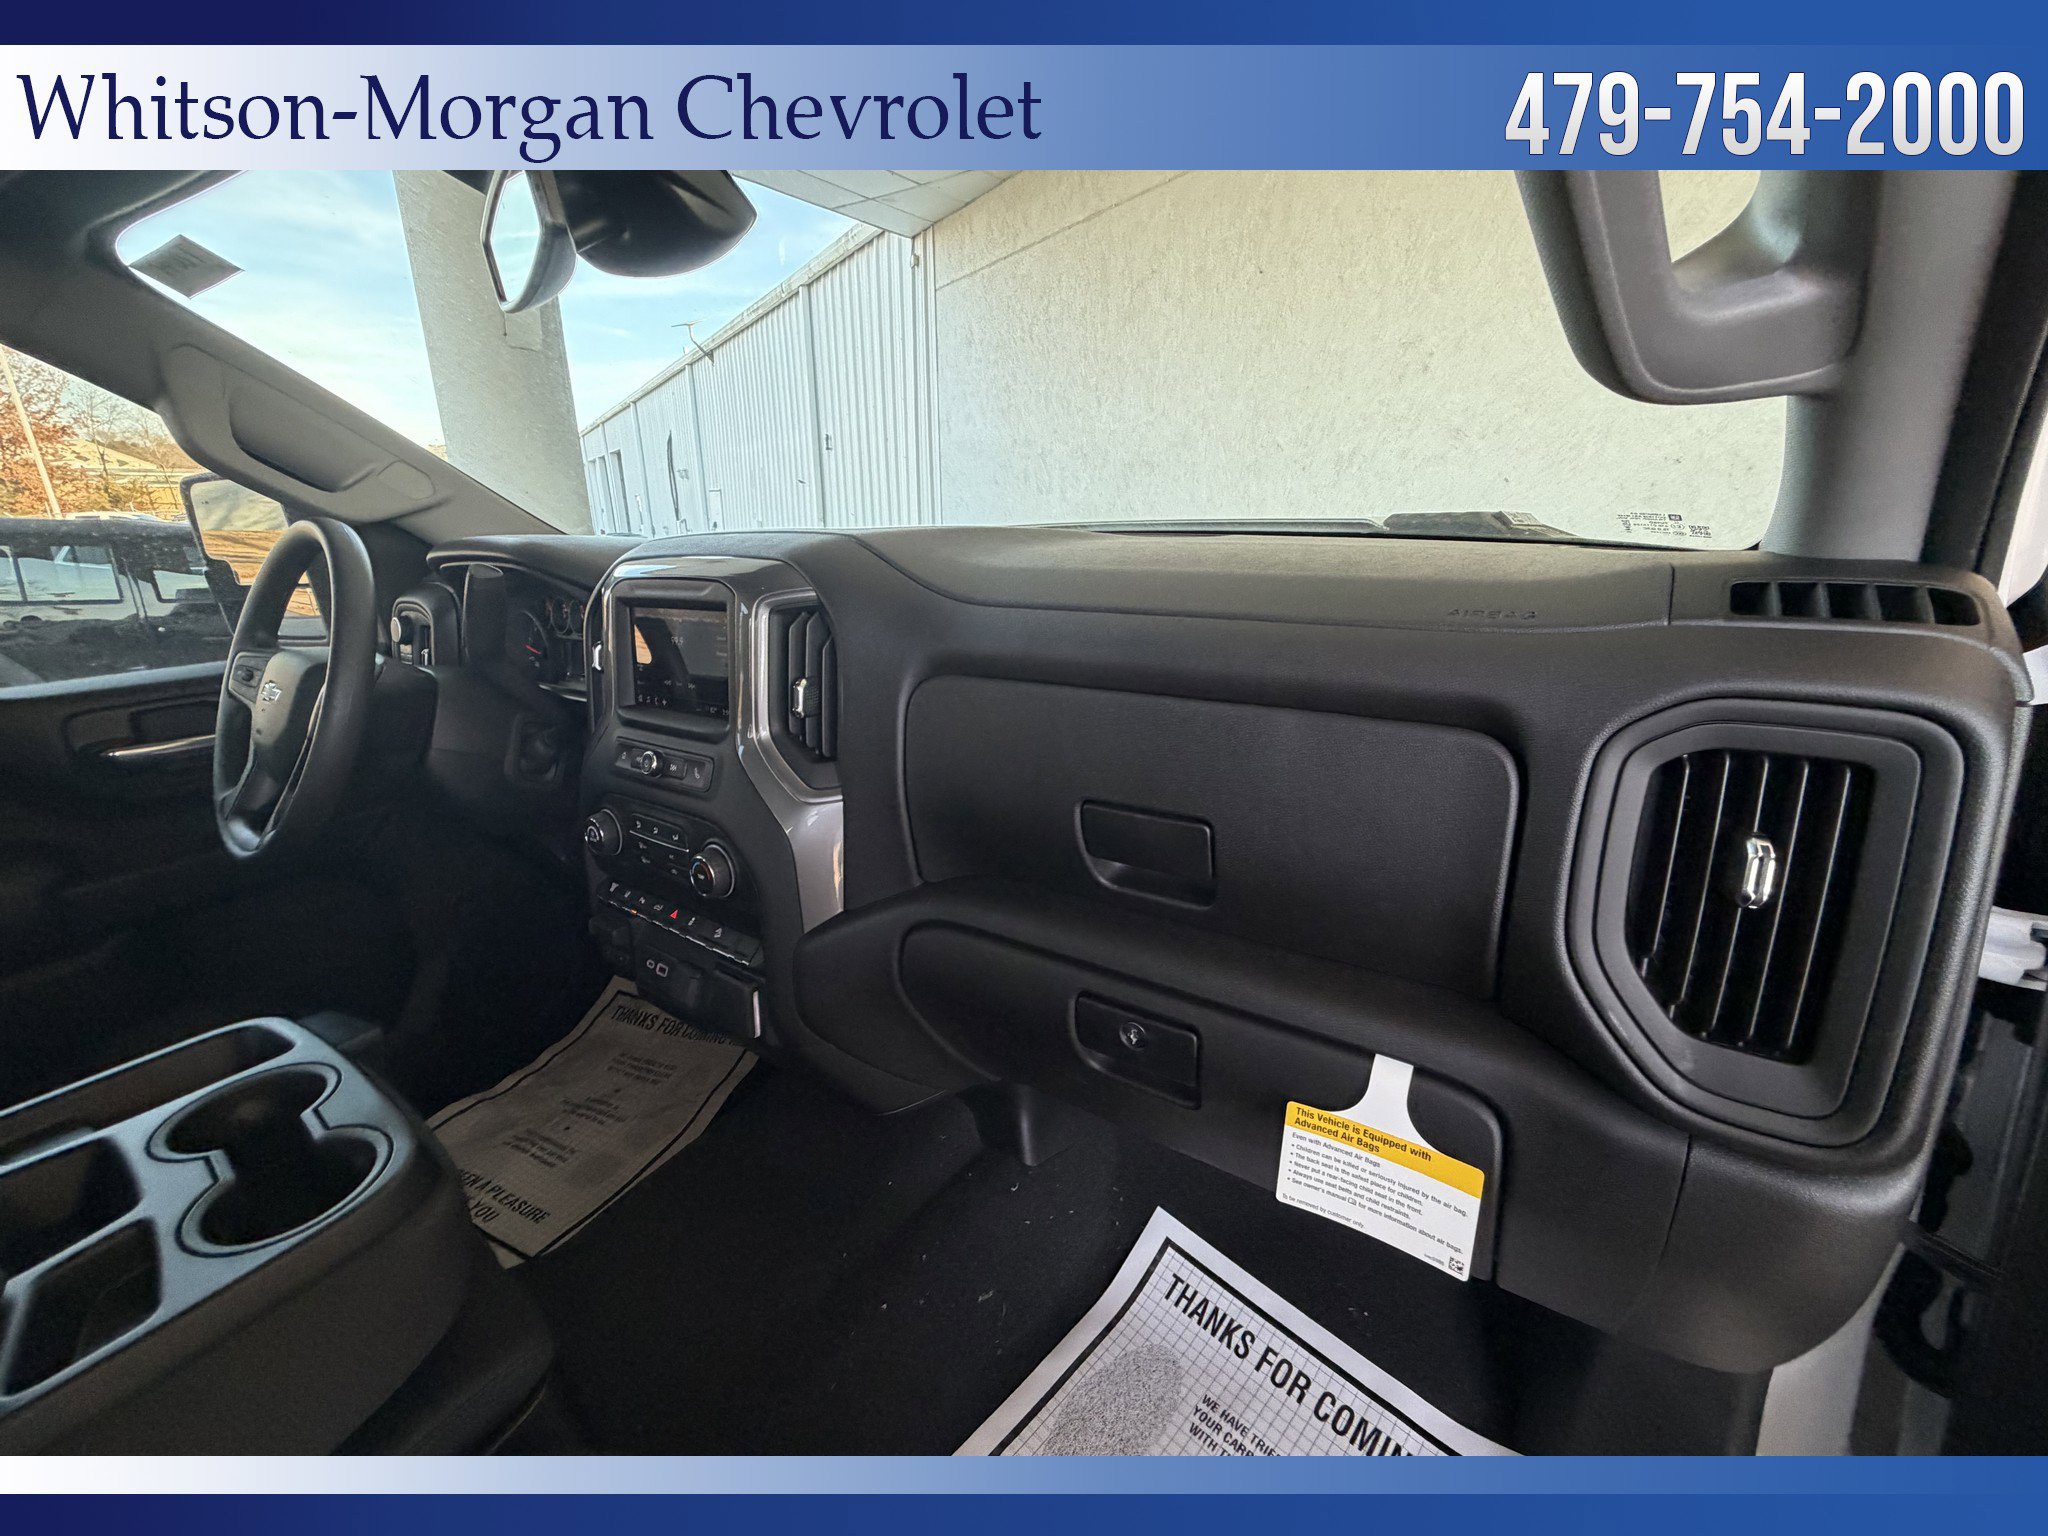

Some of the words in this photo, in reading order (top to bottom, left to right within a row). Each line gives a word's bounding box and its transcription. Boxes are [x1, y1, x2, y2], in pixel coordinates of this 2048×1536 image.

[611, 1005, 659, 1031] THANKS
[1292, 1132, 1307, 1141] Even
[1308, 1138, 1322, 1146] with
[1322, 1142, 1353, 1157] Advanced
[1354, 1153, 1364, 1161] Air
[1364, 1157, 1381, 1168] Bags
[1294, 1117, 1339, 1138] Advanced
[1340, 1132, 1355, 1143] Air
[1356, 1137, 1381, 1153] Bags
[1296, 1107, 1315, 1120] This
[1317, 1113, 1350, 1131] Vehicle
[1352, 1125, 1361, 1135] is
[1363, 1129, 1407, 1152] Equipped
[1409, 1146, 1432, 1161] with
[1293, 1169, 1313, 1181] Always
[1324, 1180, 1338, 1189] seat
[1338, 1185, 1353, 1195] belts
[1353, 1192, 1365, 1200] and
[1365, 1196, 1381, 1207] child
[1294, 1160, 1310, 1171] Never
[1326, 1172, 1359, 1190] rear-facing
[1359, 1185, 1374, 1195] child
[1374, 1191, 1388, 1200] seat
[1395, 1199, 1406, 1209] the
[1295, 1152, 1307, 1160] The
[1307, 1157, 1320, 1166] back
[1321, 1161, 1334, 1170] seat
[1340, 1169, 1351, 1178] the
[1351, 1173, 1370, 1184] safest
[1370, 1180, 1387, 1191] place
[1387, 1186, 1397, 1195] for
[1397, 1191, 1424, 1207] children.
[1296, 1144, 1320, 1156] Children
[1321, 1153, 1333, 1161] can
[1334, 1156, 1342, 1164] be
[1342, 1160, 1360, 1171] killed
[1368, 1170, 1396, 1185] seriously
[1397, 1181, 1420, 1195] injured
[1421, 1191, 1430, 1200] by
[1431, 1195, 1442, 1204] the
[1443, 1201, 1453, 1209] air
[470, 1198, 500, 1223] YOU
[485, 1184, 551, 1224] PLEASURE
[1291, 1177, 1303, 1186] See
[1326, 1190, 1347, 1202] manual
[1358, 1202, 1367, 1210] for
[1367, 1206, 1383, 1217] more
[1383, 1213, 1418, 1233] information
[1418, 1229, 1437, 1242] about
[1436, 1237, 1446, 1246] air
[1296, 1199, 1319, 1211] removed
[1327, 1210, 1353, 1223] customer
[1163, 1273, 1256, 1360] THANKS
[1254, 1345, 1313, 1405] FOR
[1193, 1404, 1223, 1436] YOUR
[1202, 1394, 1220, 1413] WE
[1219, 1409, 1250, 1438] HAVE
[1189, 1422, 1219, 1452] WITH
